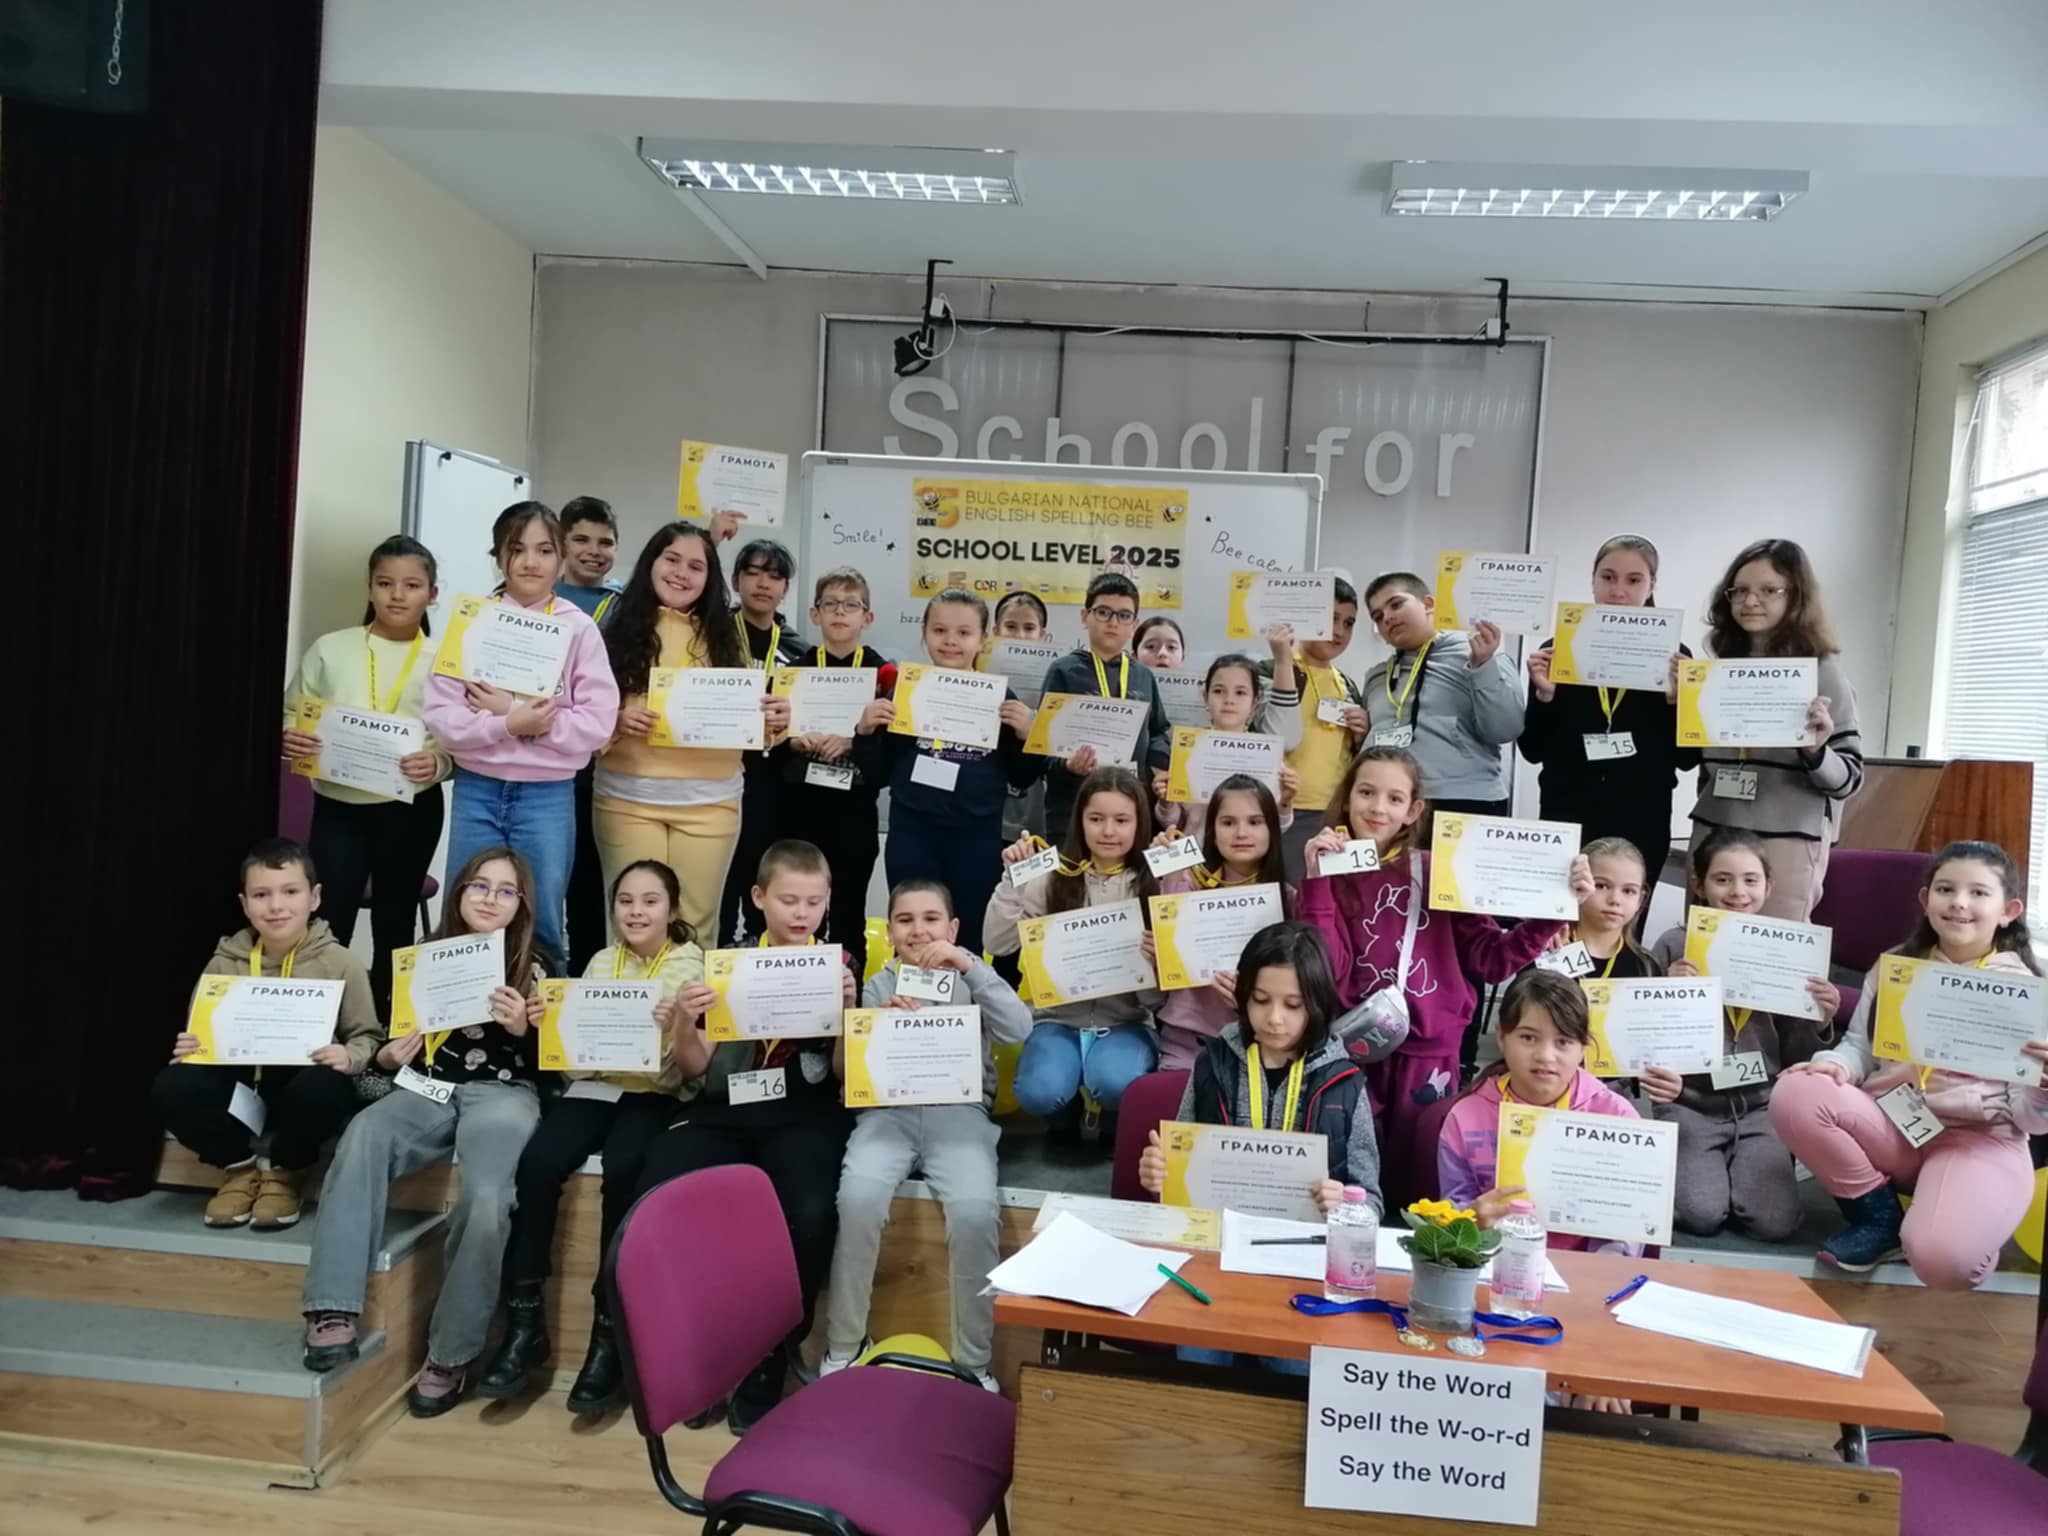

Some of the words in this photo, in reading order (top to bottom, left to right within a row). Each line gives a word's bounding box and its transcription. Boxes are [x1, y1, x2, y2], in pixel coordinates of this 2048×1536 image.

[884, 376, 1263, 475] School
[1305, 427, 1475, 497] for
[720, 455, 776, 470] ГРАМОТА
[965, 490, 1063, 508] BULGARIAN
[1068, 494, 1153, 512] NATIONAL
[965, 507, 1036, 523] ENGLISH
[1041, 510, 1120, 526] SPELLING
[1125, 513, 1153, 529] BEE
[916, 538, 1026, 563] SCHOOL
[1031, 542, 1106, 565] LEVEL
[1108, 545, 1181, 569] 2025
[1210, 530, 1243, 560] Bee
[1480, 561, 1543, 574] ГРАМОТА
[1267, 580, 1322, 588] ГРАМОТА
[497, 613, 560, 636] ГРАМОТА
[1601, 614, 1668, 628] ГРАМОТА
[1008, 646, 1059, 659] ГРАМОТА
[691, 676, 752, 687] ГРАМОТА
[811, 676, 865, 685] ГРАМОТА
[938, 675, 994, 691] ГРАМОТА
[1729, 669, 1801, 679] ГРАМОТА
[1079, 702, 1134, 716] ГРАМОТА
[341, 715, 410, 737] ГРАМОТА
[1213, 739, 1271, 751] ГРАМОТА
[1609, 738, 1635, 756] 15
[838, 769, 850, 785] 2
[1738, 778, 1757, 797] 12
[1485, 827, 1563, 845] ГРАМОТА
[1182, 839, 1198, 858] 4
[1042, 851, 1055, 869] 5
[1349, 848, 1378, 869] 13
[1199, 895, 1266, 913] ГРАМОТА
[1063, 911, 1128, 933] ГРАМОТА
[1741, 924, 1815, 946] ГРАМОТА
[432, 942, 491, 962] ГРАМОТА
[755, 957, 827, 969] ГРАМОТА
[1561, 949, 1592, 975] 14
[250, 986, 326, 998] ГРАМОТА
[584, 988, 649, 1000] ГРАМОТА
[936, 974, 951, 995] 6
[1633, 988, 1707, 1000] ГРАМОТА
[1940, 975, 2030, 1000] ГРАМОТА
[894, 1017, 965, 1029] ГРАМОТА
[1735, 1060, 1765, 1082] 24
[421, 1083, 451, 1102] 30
[759, 1077, 785, 1098] 16
[1564, 1125, 1656, 1148] ГРАМОТА
[1901, 1115, 1933, 1145] 11
[1220, 1139, 1308, 1158] ГРАМОТА
[1343, 1362, 1389, 1391] Say
[1397, 1369, 1437, 1392] the
[1445, 1373, 1512, 1400] Word
[1320, 1407, 1382, 1433] Spell
[1390, 1415, 1429, 1436] the
[1437, 1418, 1531, 1448] W-o-r-d
[1338, 1454, 1384, 1483] Say
[1392, 1461, 1432, 1483] the
[1440, 1464, 1506, 1490] Word
